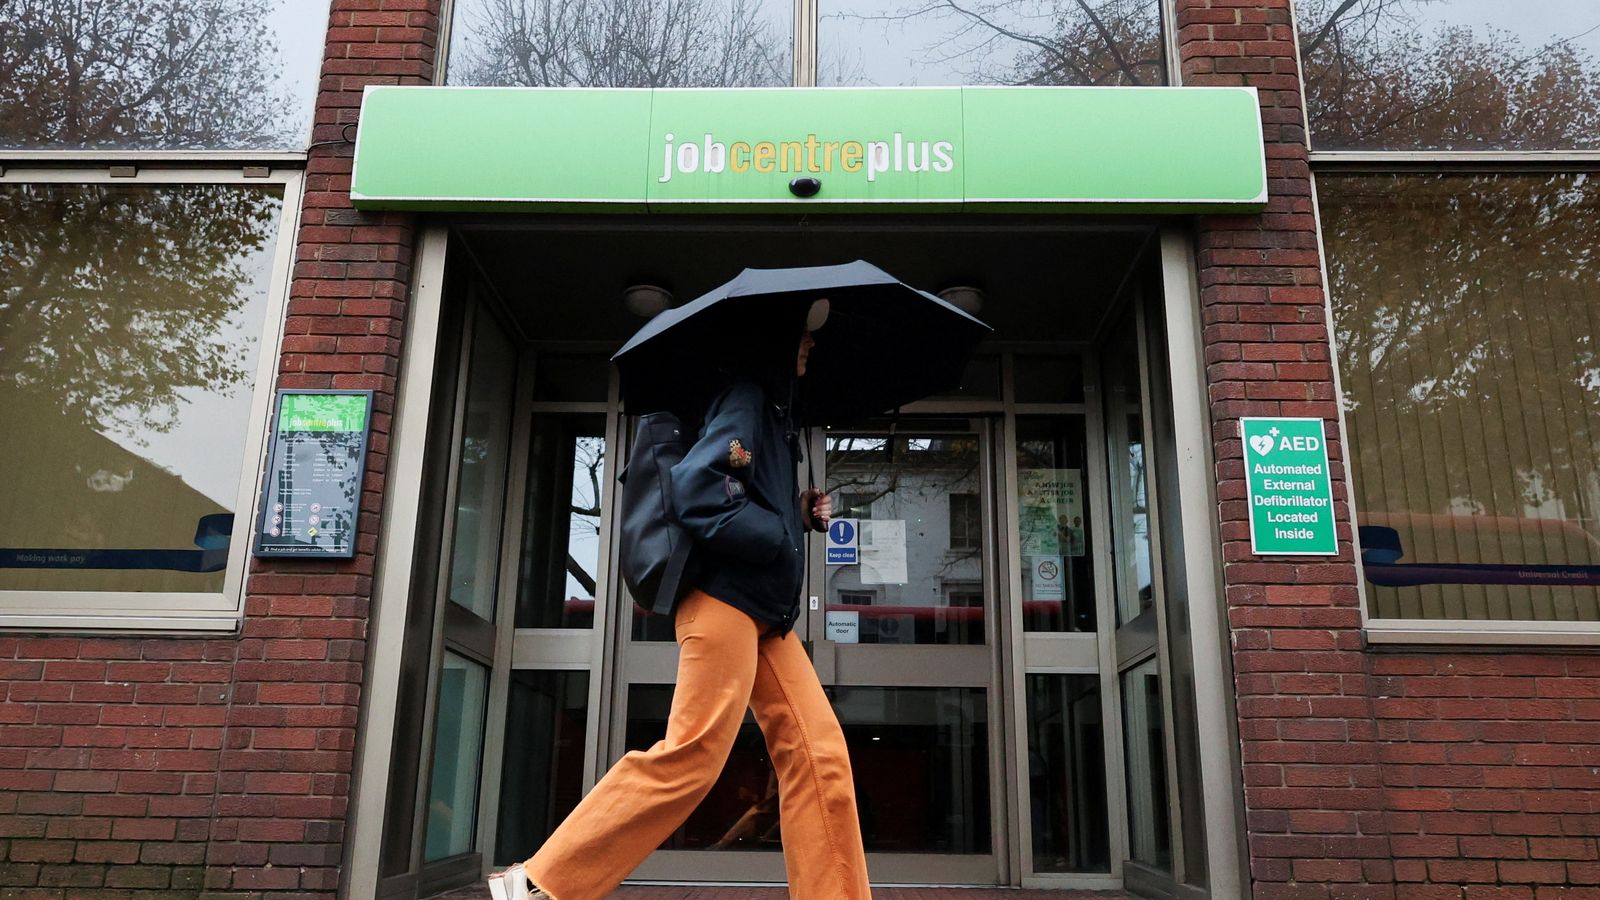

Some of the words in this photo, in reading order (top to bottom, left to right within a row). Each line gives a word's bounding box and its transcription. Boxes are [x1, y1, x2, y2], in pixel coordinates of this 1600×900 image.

[658, 132, 954, 183] jobcentreplus
[1279, 436, 1319, 451] AED
[1254, 463, 1322, 475] Automated
[1263, 479, 1315, 491] External
[1254, 495, 1329, 507] Defibrillator
[1267, 511, 1319, 523] Located
[1274, 528, 1314, 539] Inside
[16, 553, 46, 563] Making
[70, 555, 85, 564] pay
[829, 551, 842, 559] Keep
[1518, 570, 1559, 578] Universal
[1562, 570, 1588, 578] Credit
